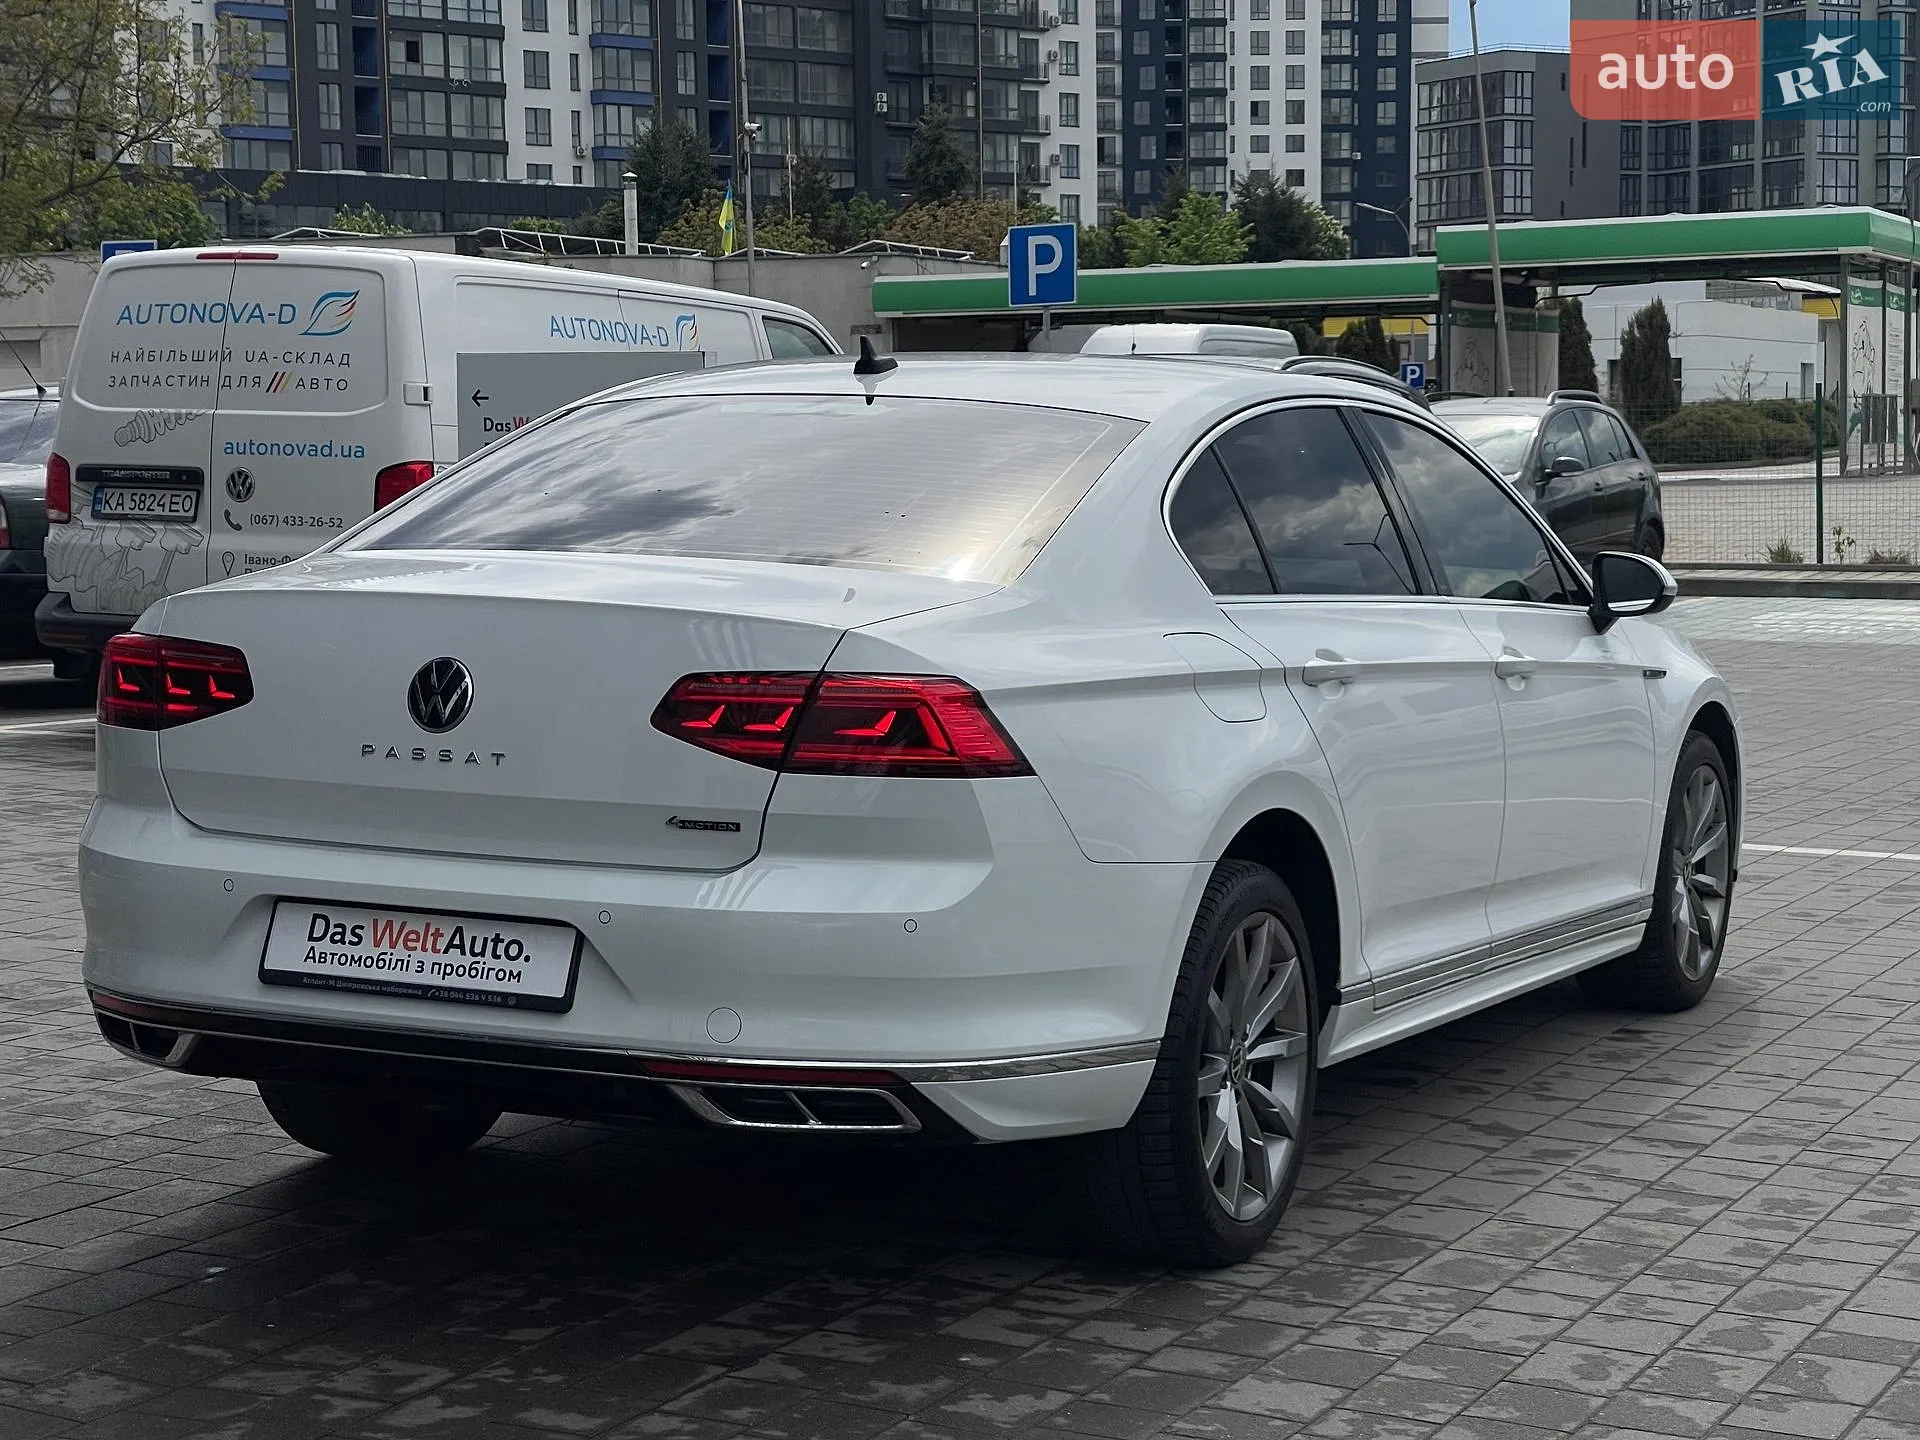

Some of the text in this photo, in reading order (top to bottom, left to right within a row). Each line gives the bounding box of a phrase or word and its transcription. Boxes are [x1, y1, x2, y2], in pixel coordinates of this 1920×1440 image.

[1027, 234, 1063, 297] P
[116, 302, 298, 326] AUTONOVA-D
[550, 314, 669, 348] AUTONOVA-D
[110, 347, 233, 364] НАЙБІЛЬШИЙ
[108, 374, 349, 392] ЗАПЧАСТИН ДЛЯ АВТО
[483, 417, 512, 433] Das
[223, 440, 366, 459] autonovad.ua
[249, 513, 344, 529] (067) 433-26-52
[244, 553, 296, 567] Івано-Ф
[361, 743, 506, 767] PASSAT
[307, 912, 532, 963] Das WeltAuto.
[303, 945, 523, 984] Автомобілі з пробігом
